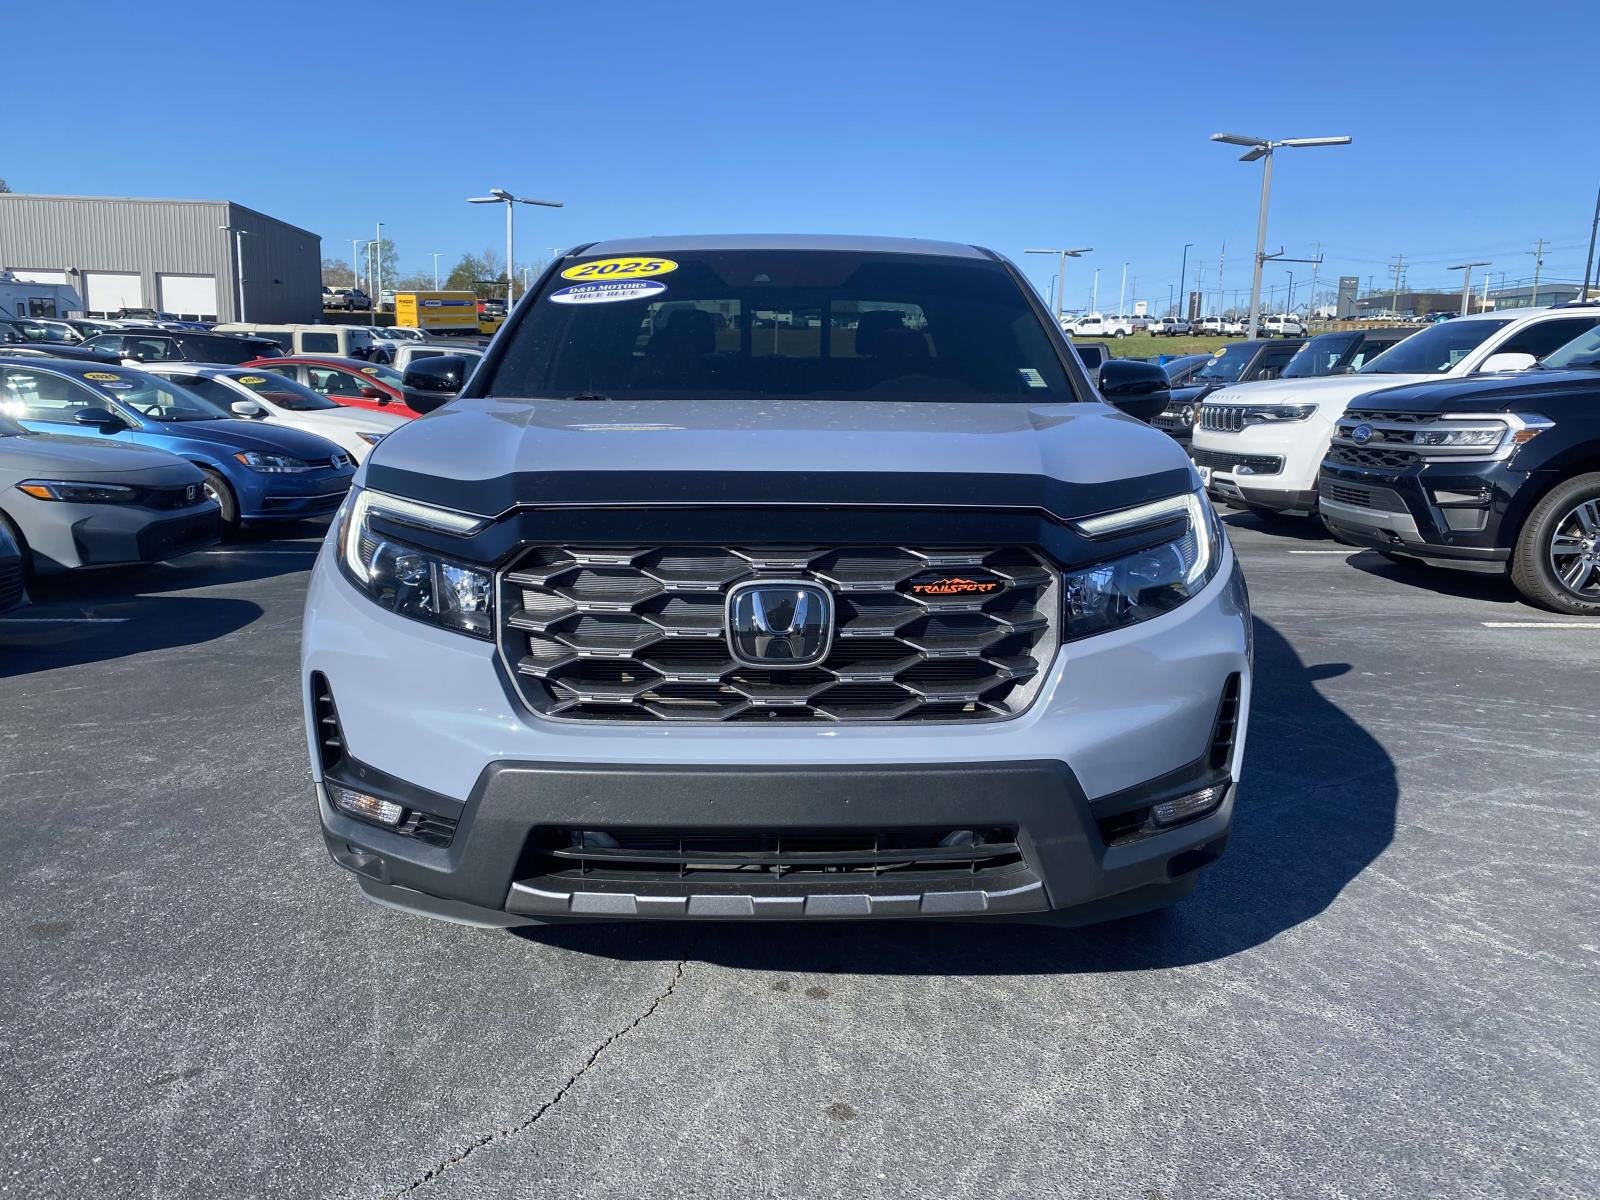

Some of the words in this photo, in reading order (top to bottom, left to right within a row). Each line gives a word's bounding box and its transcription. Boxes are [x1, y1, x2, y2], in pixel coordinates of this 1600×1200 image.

[573, 262, 665, 277] 2025
[569, 286, 596, 294] D&D
[598, 282, 647, 291] MOTORS
[913, 583, 997, 594] TRAILSPORT
